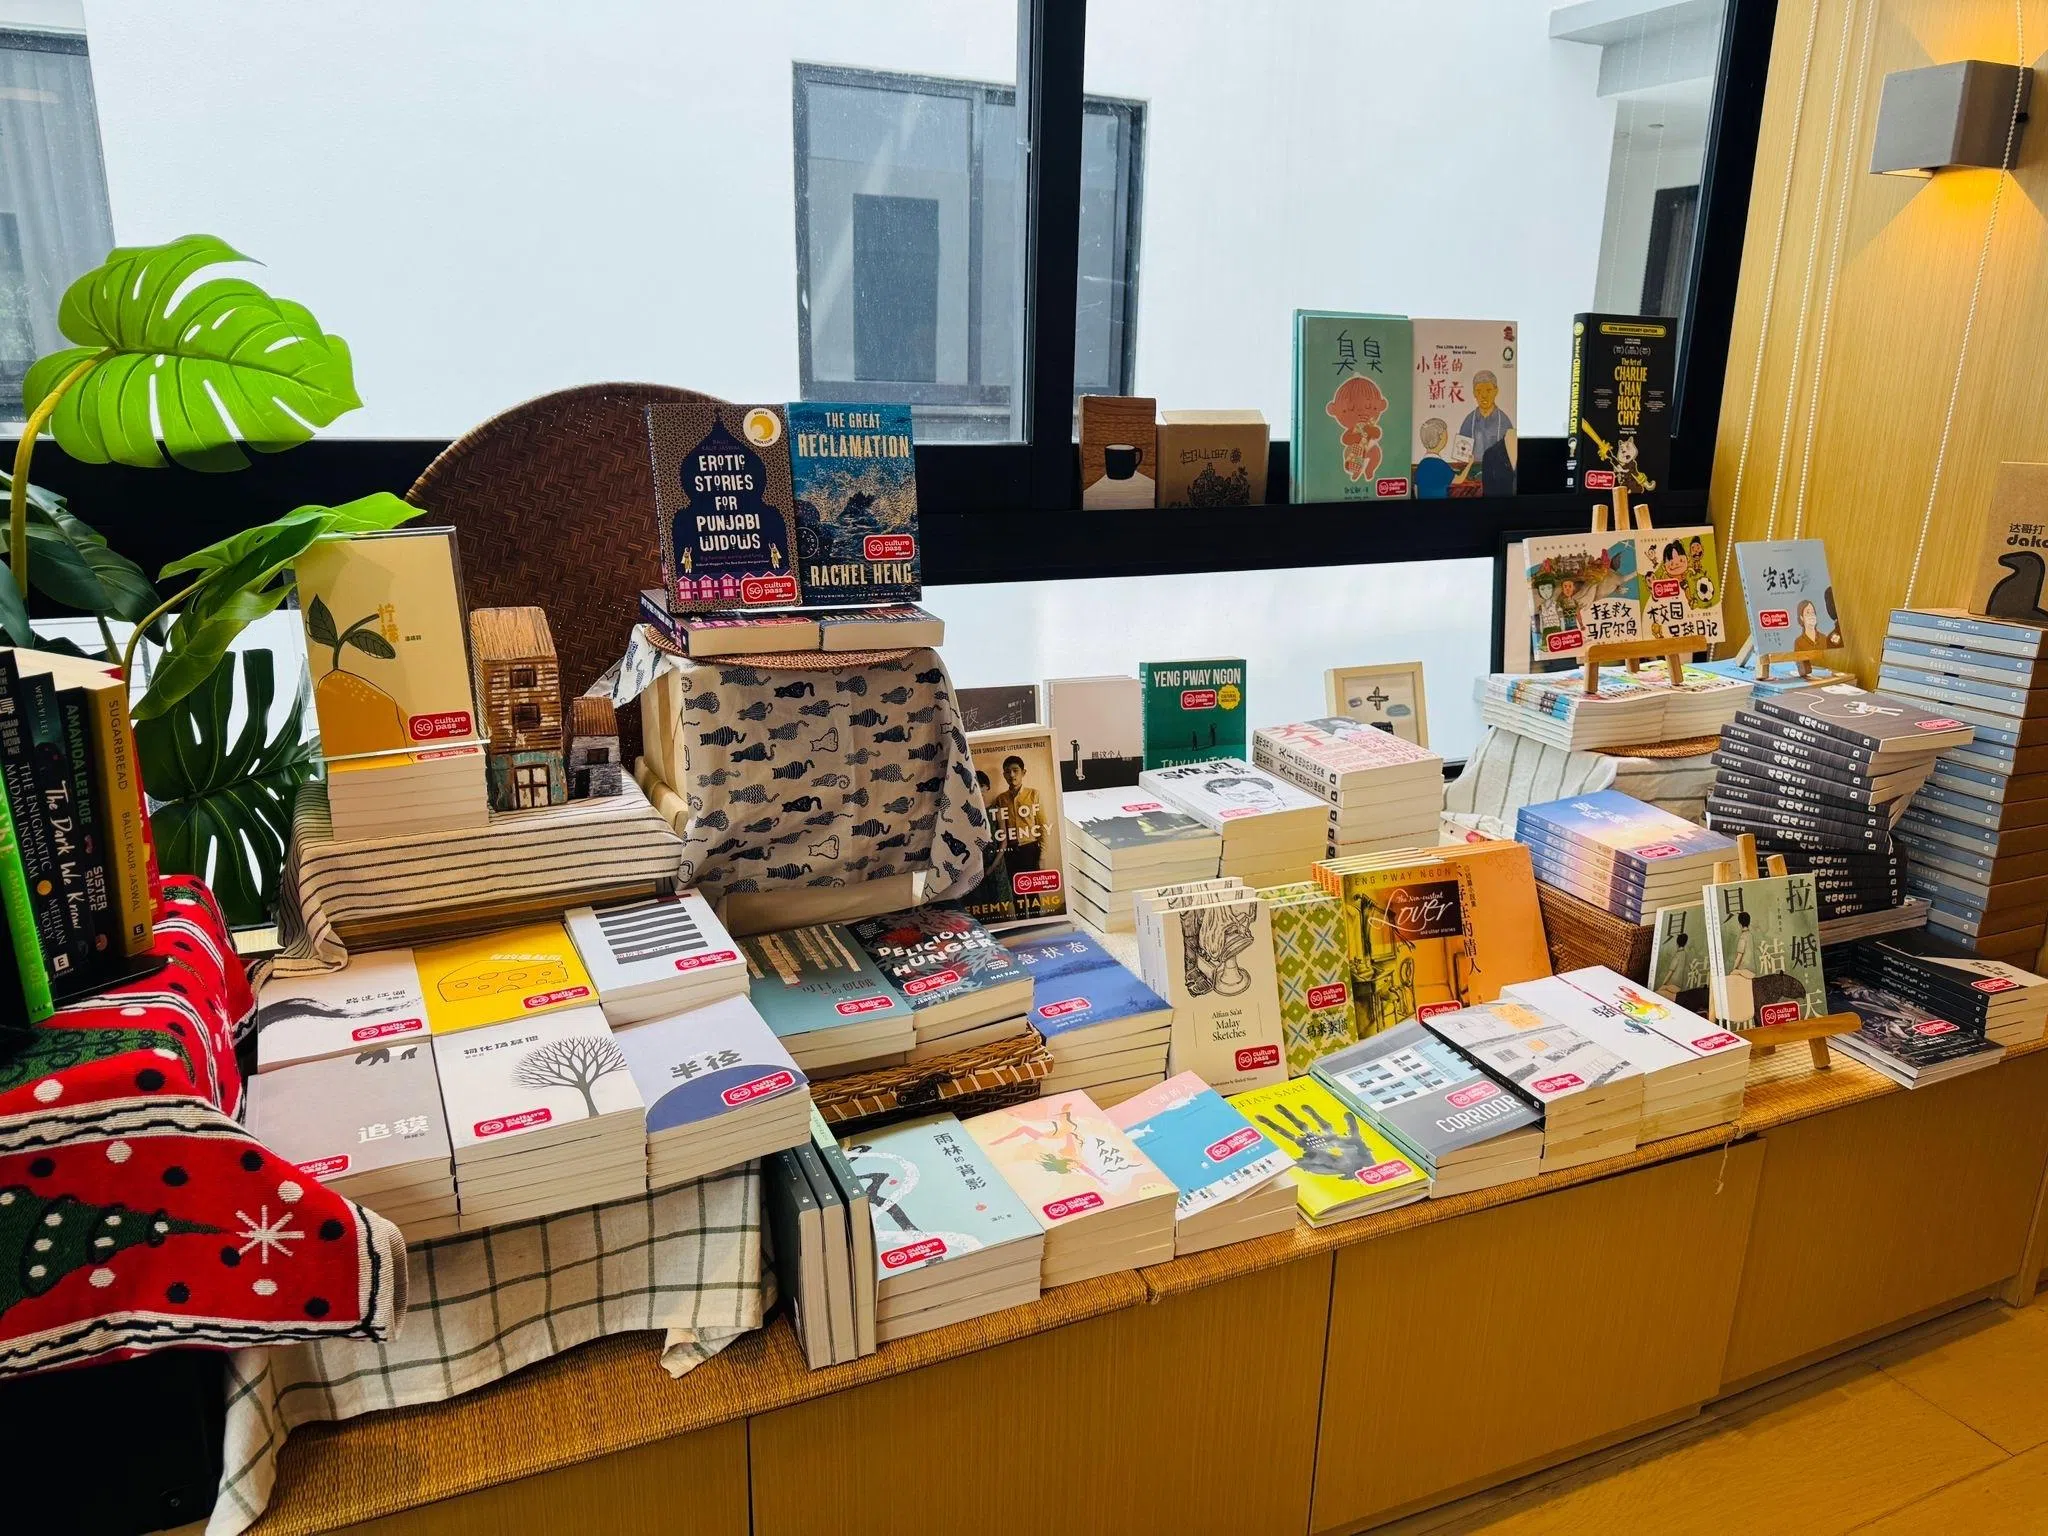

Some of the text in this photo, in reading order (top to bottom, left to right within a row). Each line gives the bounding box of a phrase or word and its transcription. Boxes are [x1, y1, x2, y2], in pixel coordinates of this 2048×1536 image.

[1332, 329, 1383, 375] 臭臭
[1417, 353, 1462, 375] 小熊的
[1614, 366, 1648, 382] CHARLIE
[1428, 379, 1465, 403] 新衣
[1619, 381, 1641, 396] CHAN
[1617, 395, 1641, 411] HOCK
[825, 412, 880, 429] THE GREAT
[1618, 410, 1640, 426] CHYE
[797, 433, 909, 458] RECLAMATION
[698, 454, 745, 472] EROTIC
[695, 474, 754, 492] STORIES
[715, 496, 737, 511] FOR
[696, 513, 760, 532] PUNJABI
[2009, 523, 2045, 535] 达哥打
[699, 533, 761, 552] WIDOWS
[810, 563, 912, 587] RACHEL HENG
[1591, 602, 1632, 620] 拯救
[1647, 601, 1683, 624] 校园
[1586, 617, 1637, 639] 马尼尔岛
[1154, 668, 1241, 688] YENG PWAY NGON
[416, 722, 431, 732] SG
[434, 716, 466, 724] culture
[435, 723, 457, 731] pass
[108, 700, 128, 790] SUGARBREAD
[65, 704, 91, 824] AMANDA LEE KOE
[5, 764, 39, 878] MADAM INGRAM
[19, 763, 52, 871] THE ENIGMATIC
[1018, 804, 1040, 817] OF
[988, 823, 1054, 842] GENCY
[45, 780, 86, 929] The Dark We Know
[122, 812, 142, 912] BALLI KAUR JASWAL
[1383, 872, 1412, 883] PWAY
[1420, 868, 1451, 879] NGON
[84, 872, 97, 911] SNAKE
[93, 865, 108, 911] SISTER
[1786, 878, 1814, 914] 拉
[1017, 895, 1060, 909] TIANG
[1368, 889, 1453, 932] Lover
[40, 910, 55, 941] BOEY
[49, 898, 67, 946] MEIHAN
[877, 930, 985, 957] DELICIOUS
[1791, 933, 1818, 969] 婚
[892, 938, 997, 977] HUNGER
[1212, 1011, 1229, 1019] Alfian
[1216, 1019, 1240, 1030] Malay
[1212, 1029, 1246, 1041] Sketches
[670, 1049, 742, 1079] 半径
[1240, 1056, 1250, 1064] SG
[1436, 1095, 1522, 1133] CORRIDOR
[933, 1132, 987, 1191] 雨林的背影
